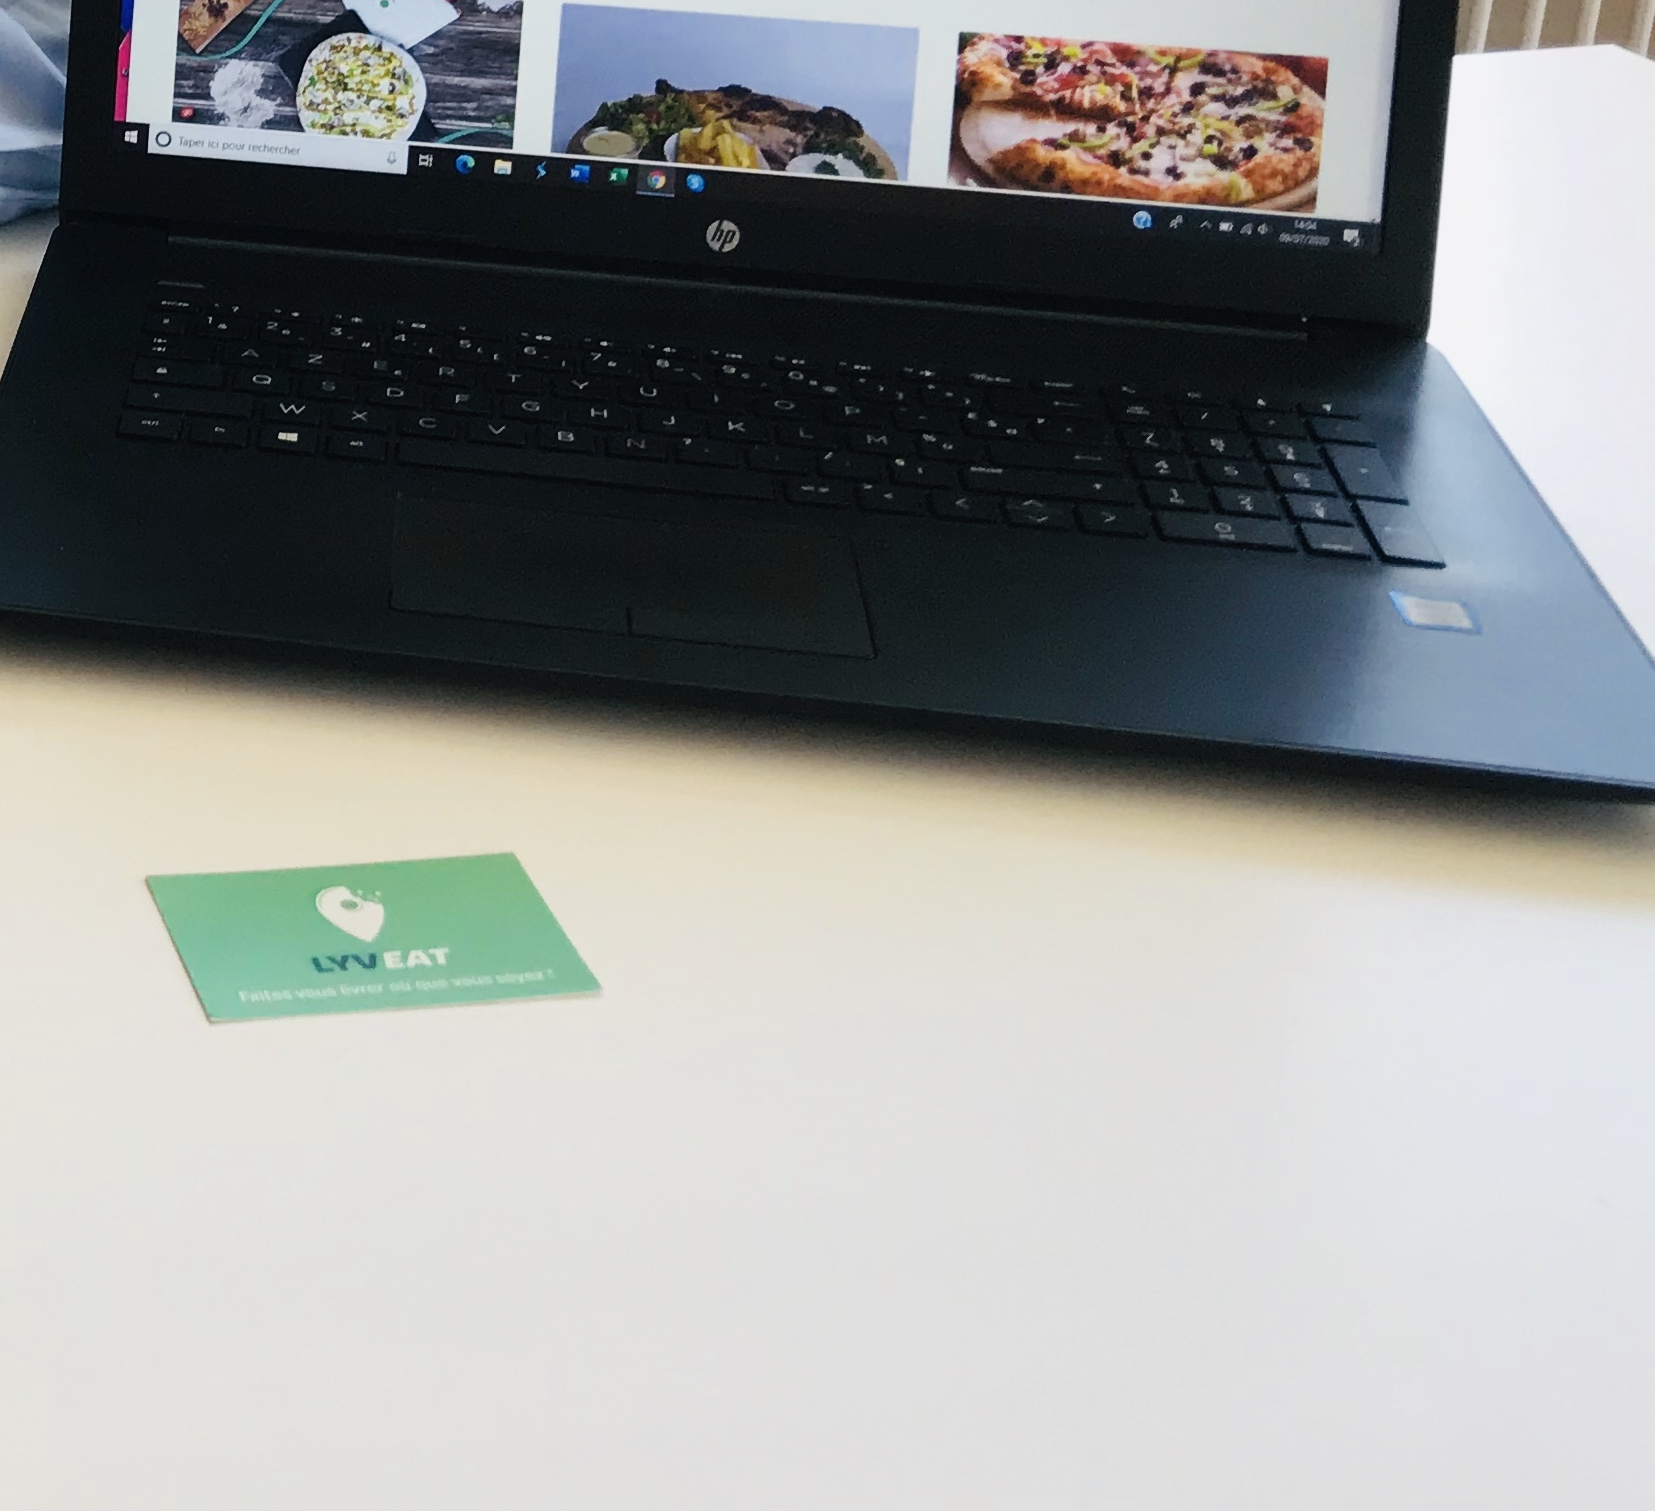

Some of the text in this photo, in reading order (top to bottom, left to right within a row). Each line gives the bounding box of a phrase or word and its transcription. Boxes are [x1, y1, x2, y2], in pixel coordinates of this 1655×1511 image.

[179, 135, 301, 156] Taper ici pour rechercher
[708, 219, 738, 252] hp
[311, 947, 449, 973] LYVEAT
[238, 988, 293, 1003] Faites
[295, 986, 337, 999] vous
[416, 978, 448, 993] que
[451, 974, 493, 987] vous
